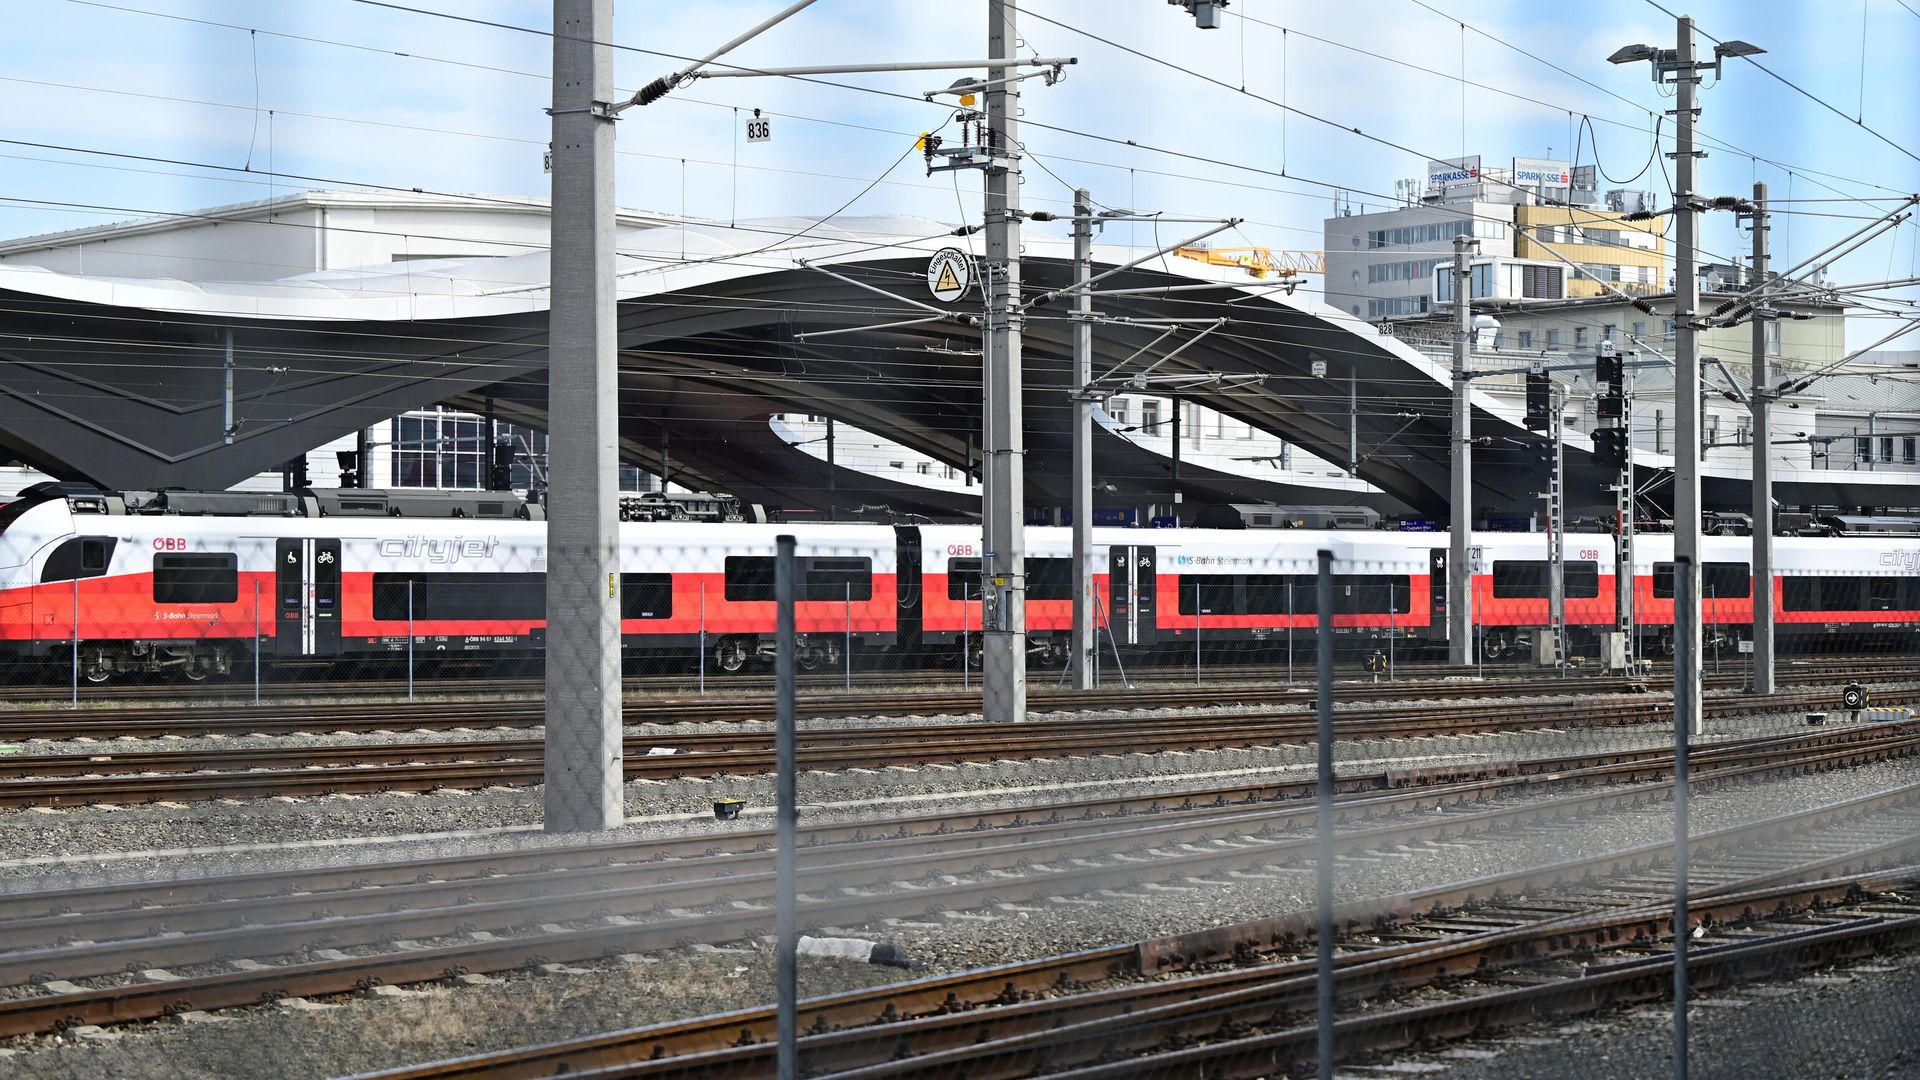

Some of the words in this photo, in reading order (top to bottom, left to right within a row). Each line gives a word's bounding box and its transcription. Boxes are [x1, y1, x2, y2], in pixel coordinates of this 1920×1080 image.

[749, 122, 769, 138] 836
[1431, 170, 1469, 181] SPARKASSE
[1517, 171, 1560, 182] SPARKSSE
[929, 251, 966, 275] Eingeschaltet
[1379, 324, 1393, 335] 828
[153, 537, 187, 551] ÖBB
[379, 534, 500, 565] cityjet
[947, 544, 973, 556] ÖBB
[1472, 547, 1481, 559] 211
[1580, 549, 1599, 560] ÖBB
[1188, 556, 1215, 565] S-Bahn
[1474, 561, 1479, 571] 4
